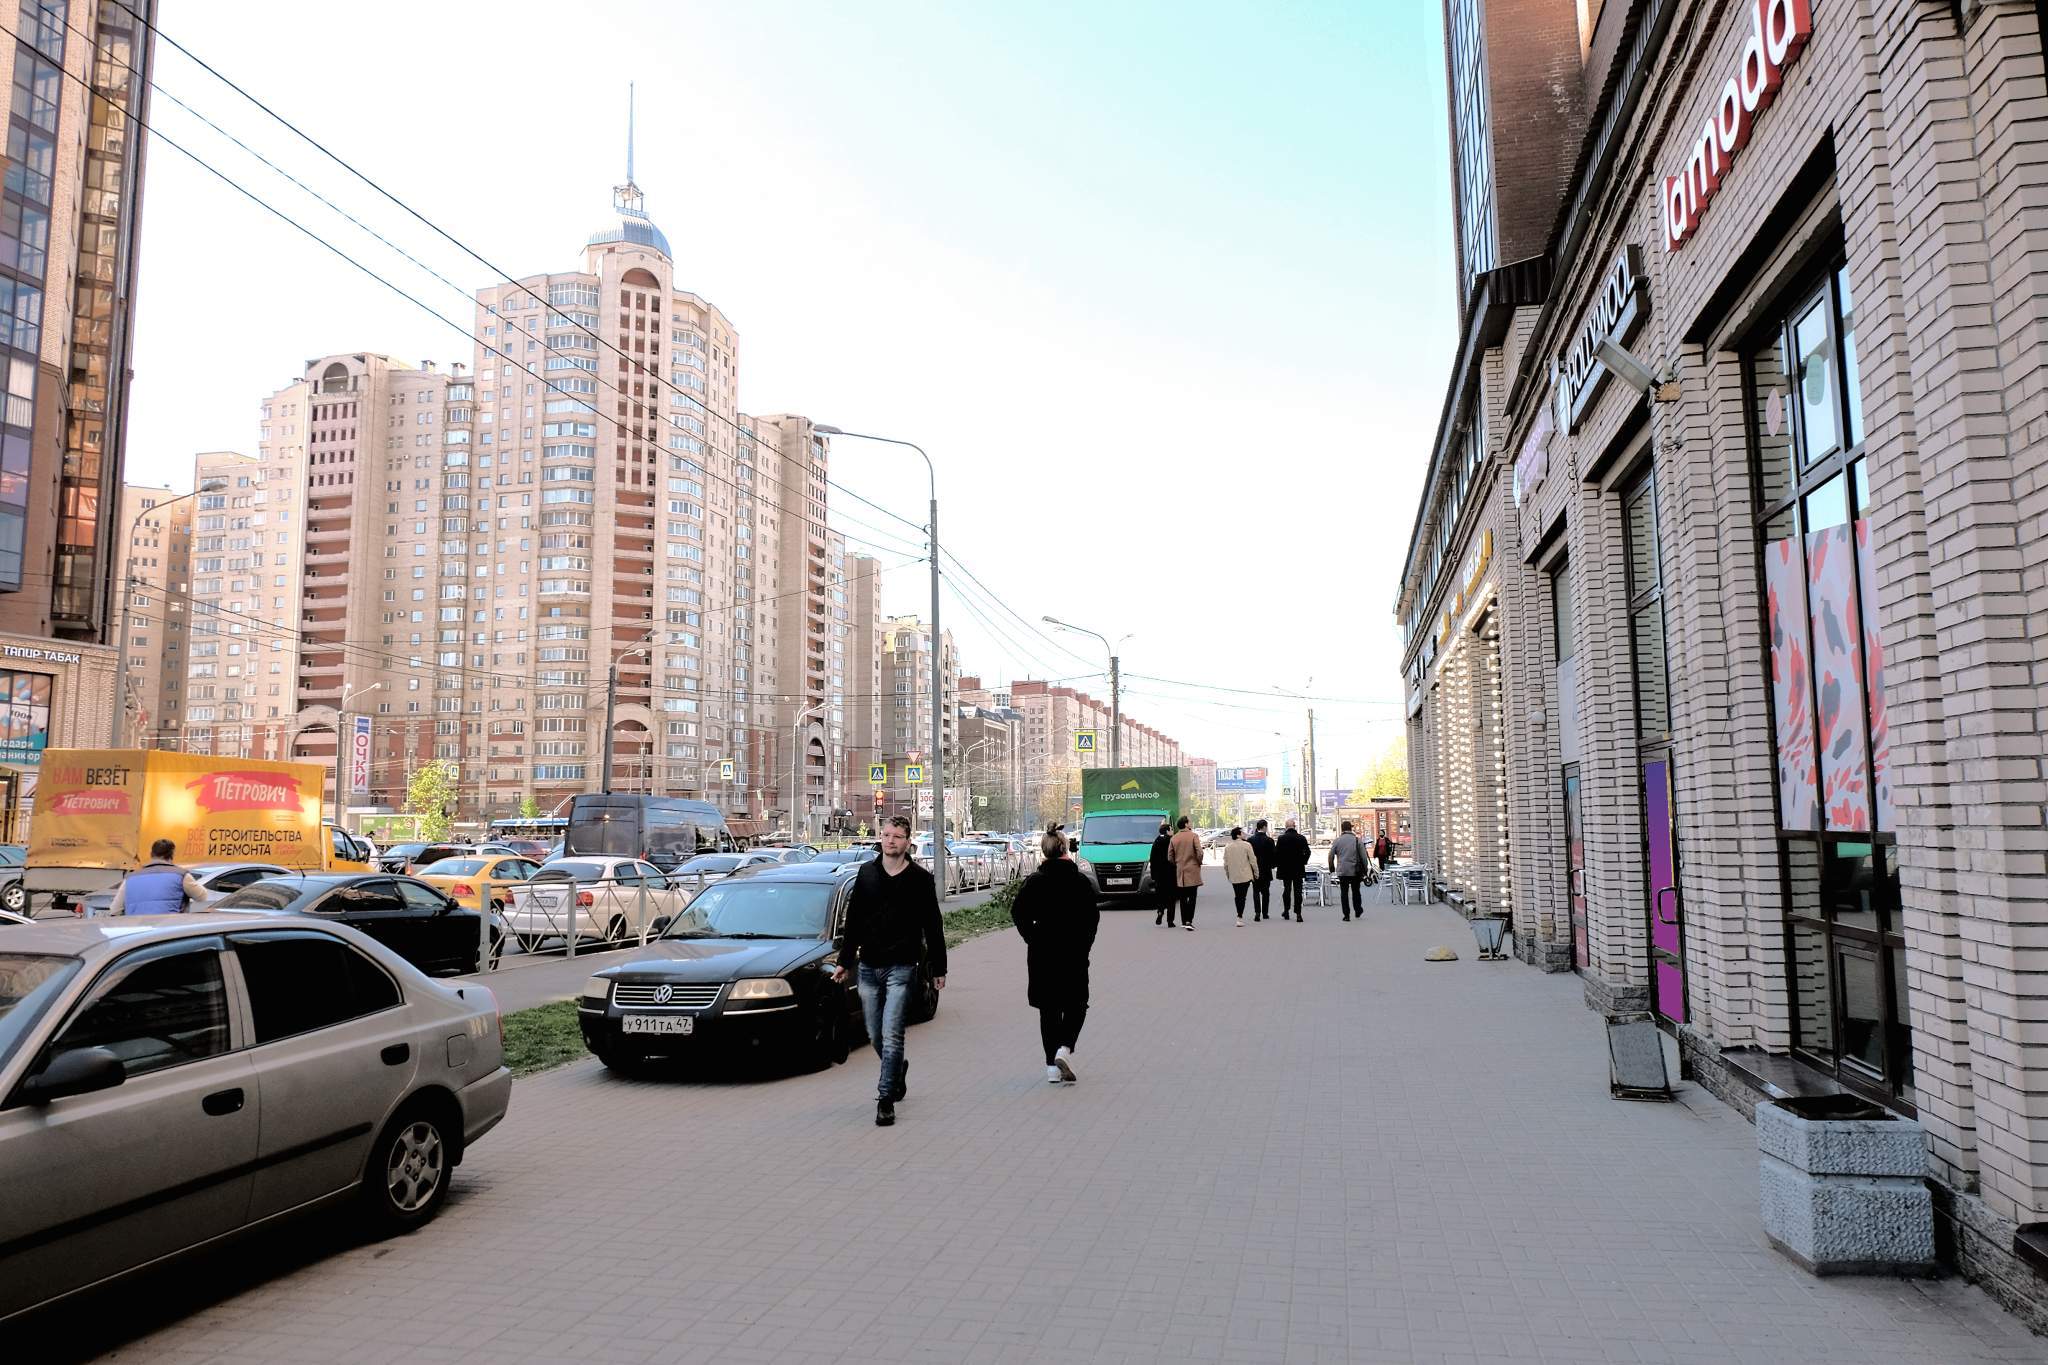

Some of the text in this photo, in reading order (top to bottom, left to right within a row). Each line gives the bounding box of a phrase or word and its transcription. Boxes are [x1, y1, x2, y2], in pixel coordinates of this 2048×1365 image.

[1663, 0, 1798, 252] lamoda
[0, 737, 34, 750] одари
[354, 735, 369, 786] ОЧКИ
[86, 764, 130, 786] ВЕЗЁТ
[209, 828, 302, 842] СТРОИТЕЛЬСТВА
[208, 844, 217, 856] И
[220, 844, 271, 856] РЕМОНТА
